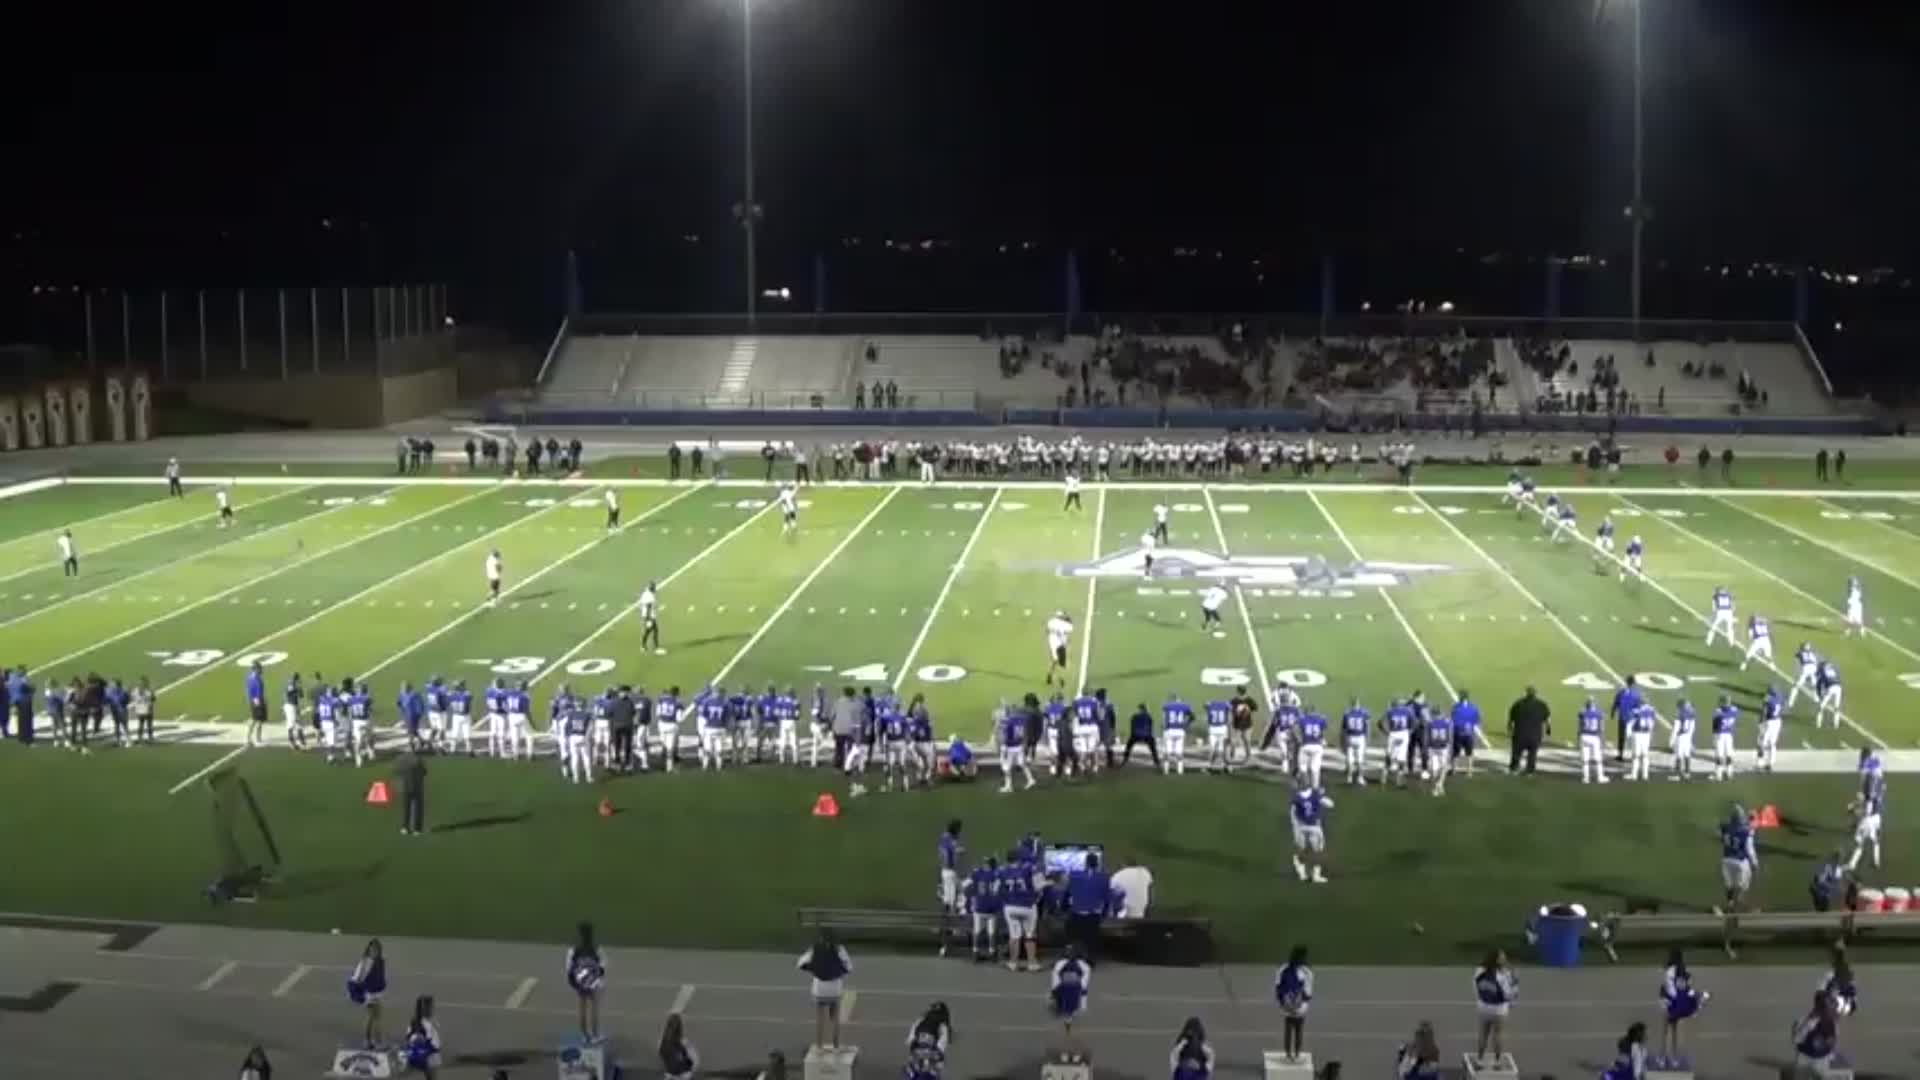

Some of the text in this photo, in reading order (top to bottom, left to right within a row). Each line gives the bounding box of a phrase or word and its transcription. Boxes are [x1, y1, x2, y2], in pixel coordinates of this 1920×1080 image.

[490, 656, 616, 675] 30
[839, 663, 967, 682] 40
[1201, 667, 1327, 687] 50
[1562, 672, 1684, 690] 40
